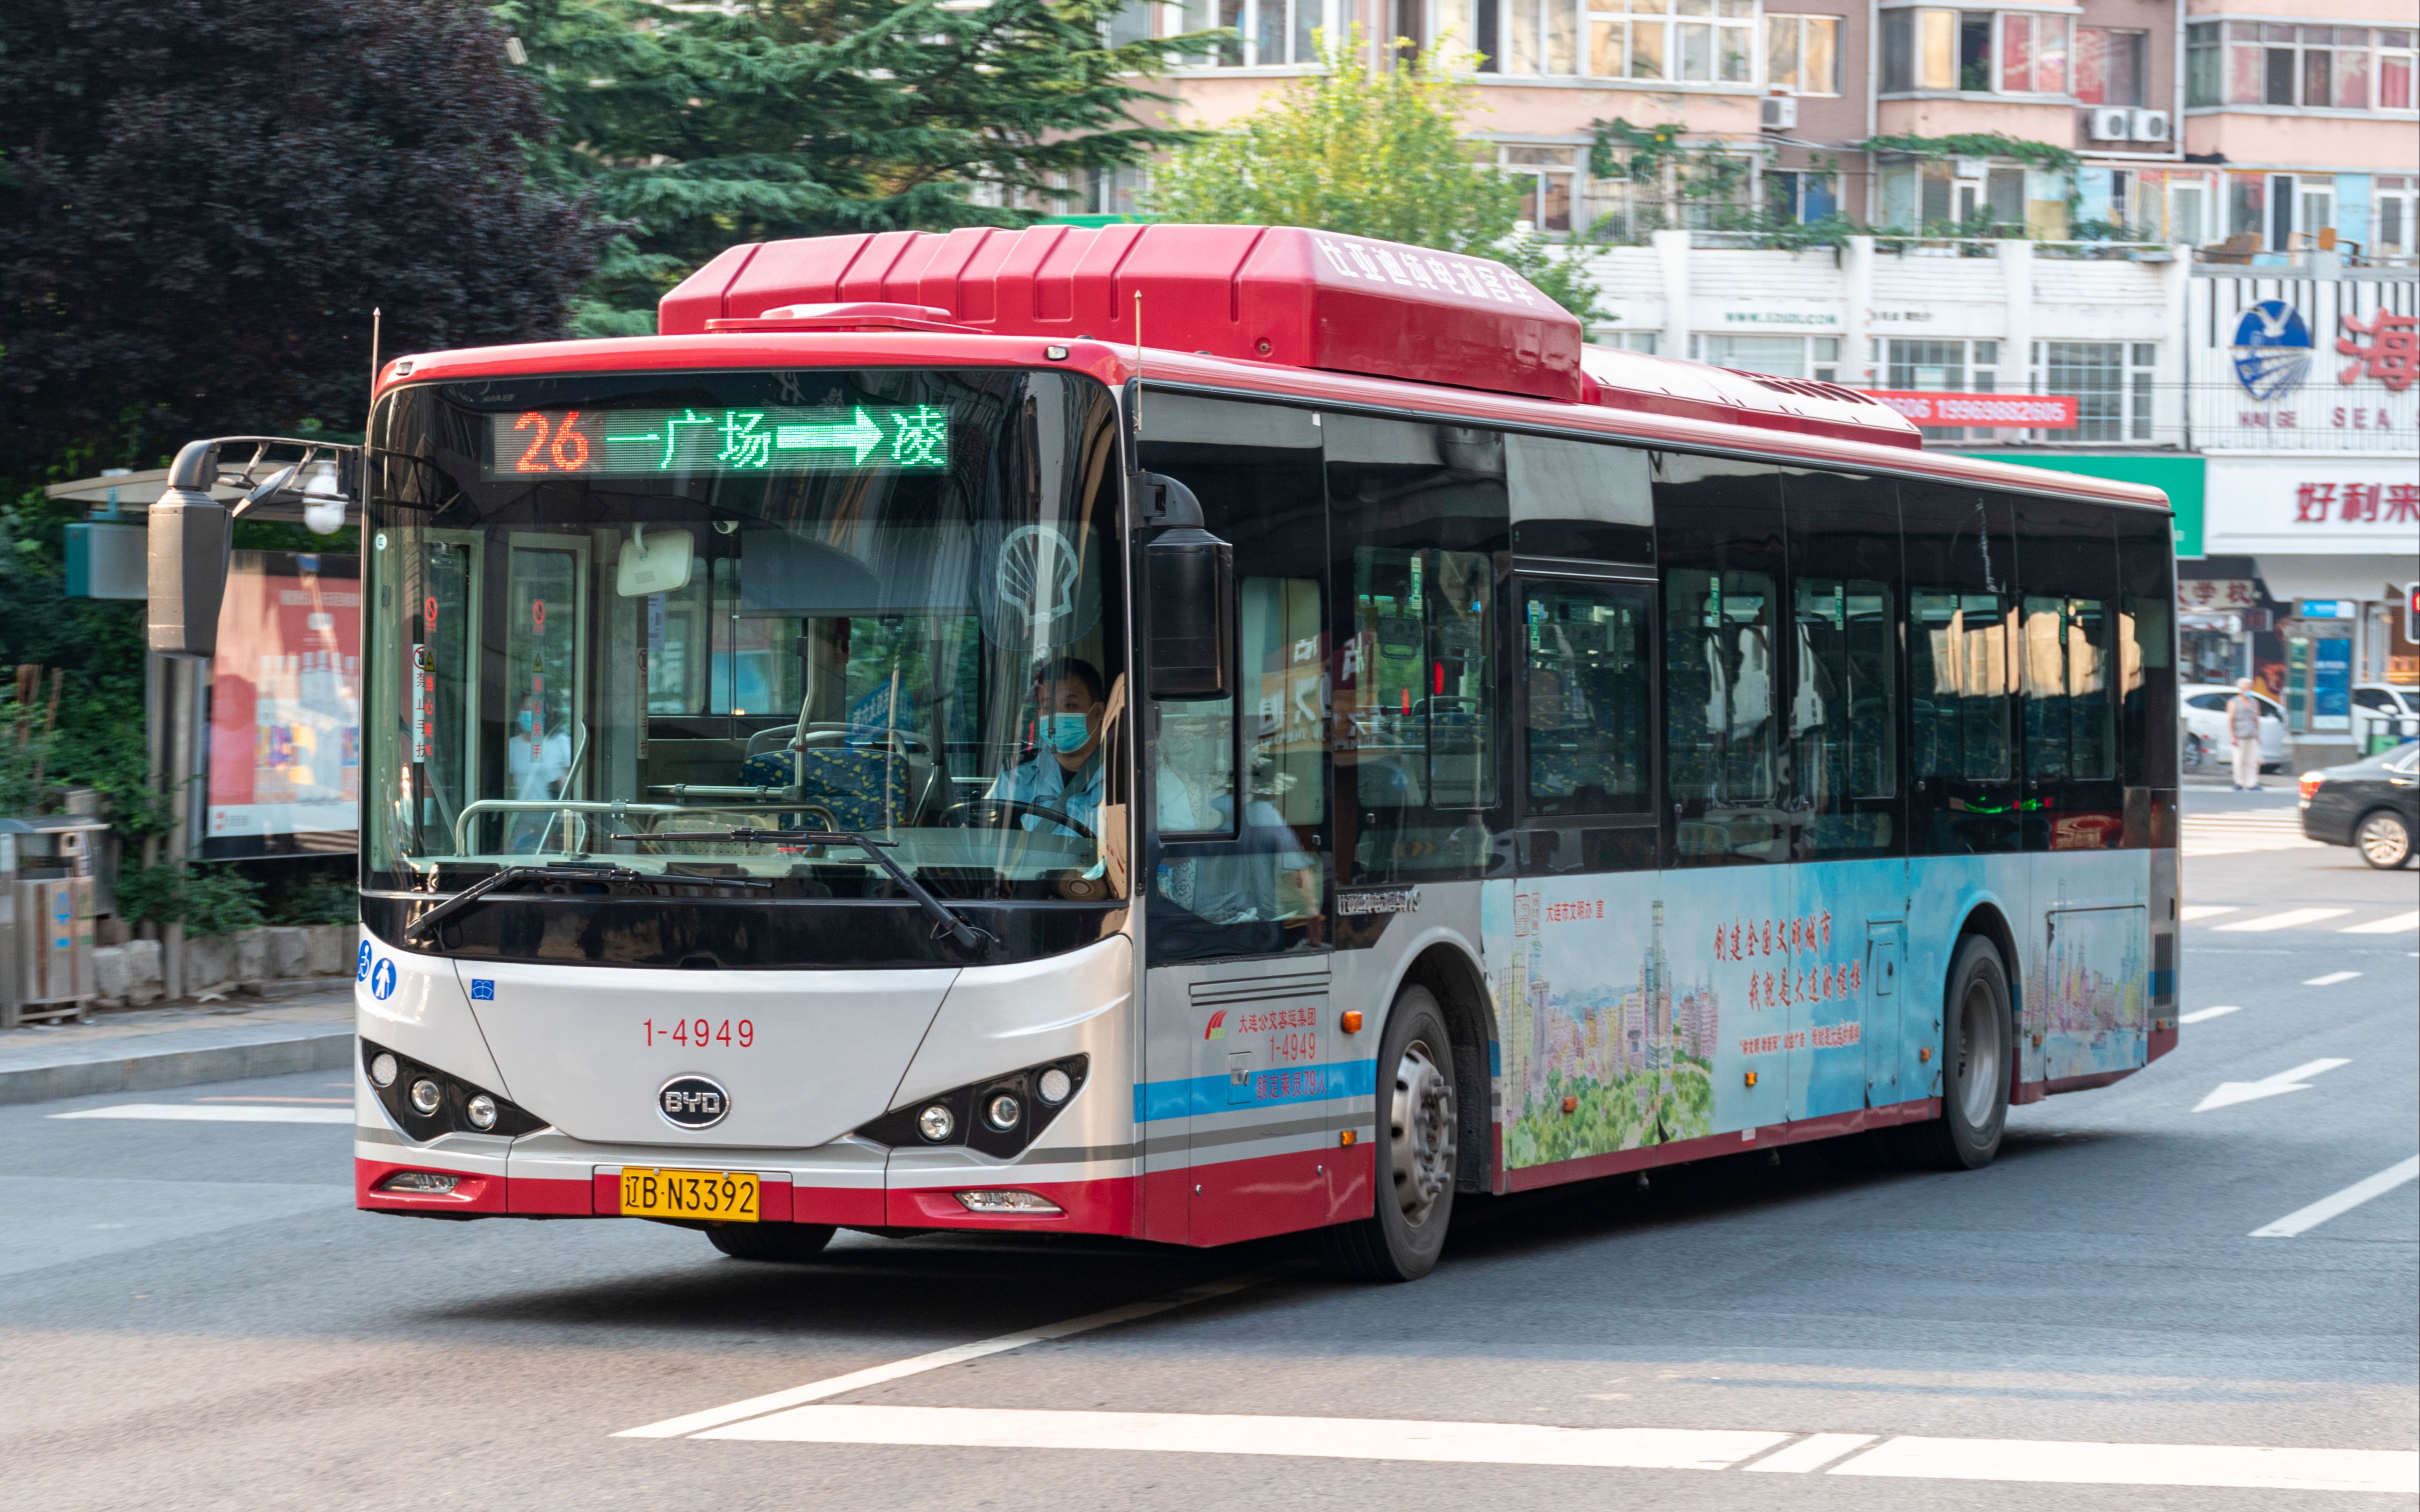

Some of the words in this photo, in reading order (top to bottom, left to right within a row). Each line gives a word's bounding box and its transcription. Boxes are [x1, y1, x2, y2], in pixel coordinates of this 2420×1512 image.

[1314, 237, 1534, 305] 比亚迪纯电动客车
[2334, 307, 2420, 392] 海
[2332, 407, 2391, 429] SEA
[514, 410, 588, 471] 26
[890, 404, 945, 466] 凌
[2293, 482, 2420, 523] 好利来
[1713, 908, 1832, 963] 创建全国文明城市
[643, 1018, 754, 1047] 1-4949
[1238, 1007, 1316, 1034] 大连公交客运集团
[1270, 1032, 1316, 1063] 1-4949
[665, 1091, 720, 1113] BYD
[1257, 1070, 1327, 1101] 额定乘员79人
[625, 1175, 754, 1213] 辽B·N3392
